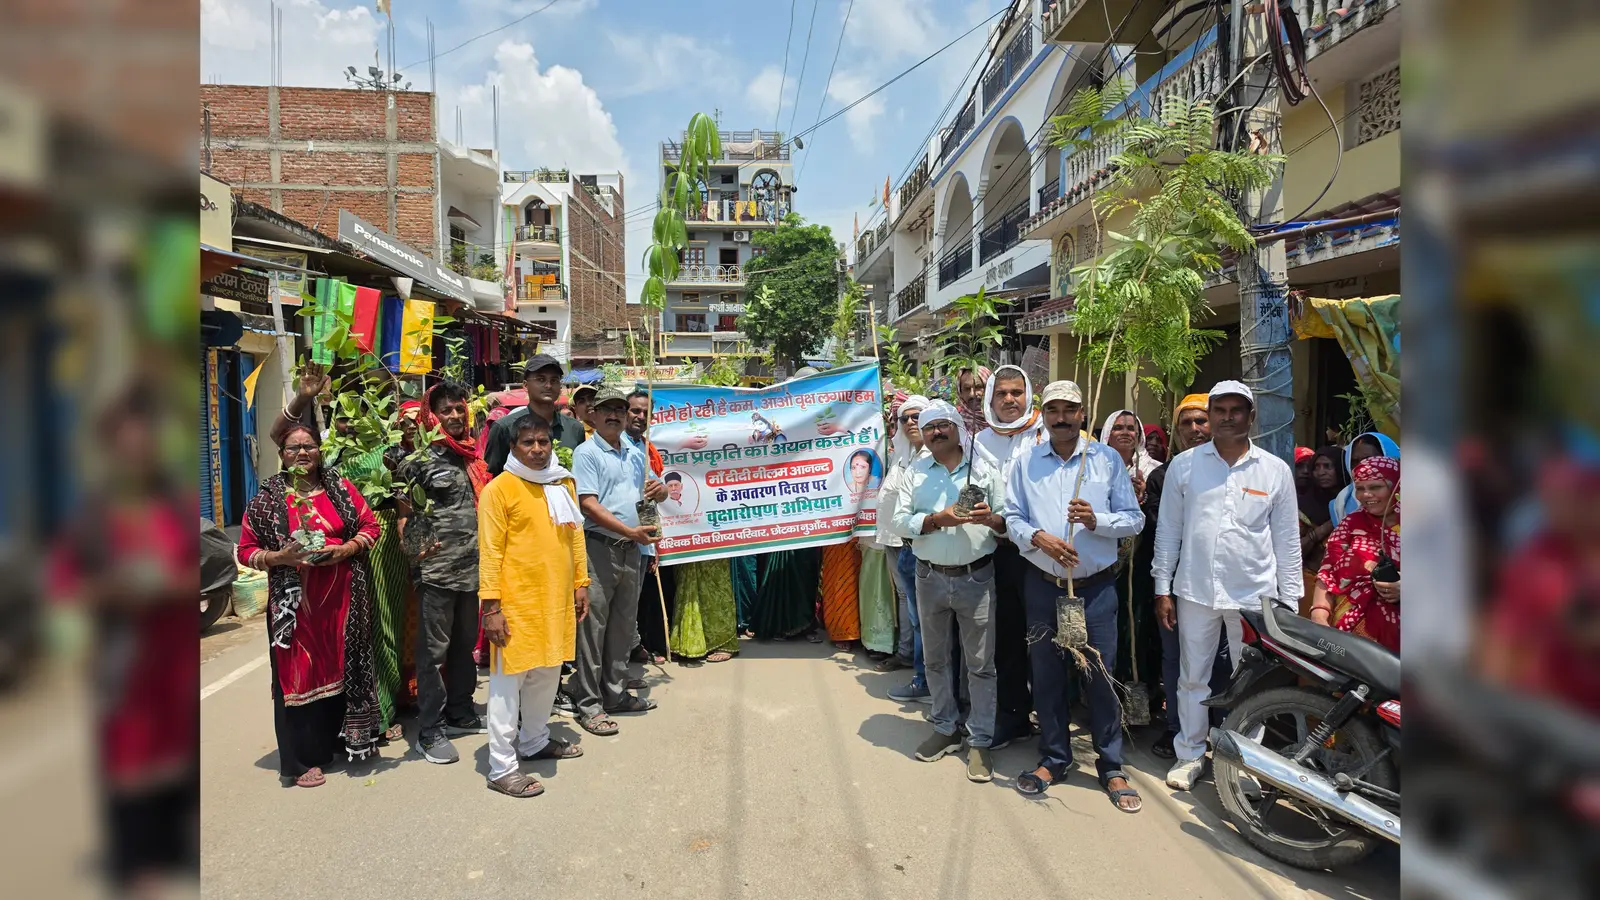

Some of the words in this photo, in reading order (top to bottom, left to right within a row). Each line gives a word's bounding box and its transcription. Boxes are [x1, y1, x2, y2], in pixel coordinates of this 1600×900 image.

[353, 222, 425, 269] Panasonic
[206, 273, 239, 289] त्यम
[678, 402, 692, 422] हो
[694, 398, 716, 418] रही
[717, 398, 727, 416] है
[760, 392, 794, 410] आओ
[795, 393, 816, 410] वृक्ष
[853, 390, 876, 404] हम
[690, 443, 742, 467] प्रकृति
[744, 444, 769, 458] का
[770, 438, 814, 455] अयन
[814, 430, 856, 449] करते
[708, 472, 725, 485] माँ
[725, 469, 752, 483] दीदी
[752, 466, 788, 480] नीलम
[789, 462, 831, 477] आनन्द
[715, 488, 728, 503] के
[730, 484, 777, 502] अवतरण
[778, 480, 811, 496] दिवस
[812, 478, 828, 492] पर
[706, 502, 779, 528] वृक्षारोपण
[780, 494, 844, 517] अभियान
[658, 537, 691, 550] वैश्विक
[692, 534, 711, 546] शिव
[711, 531, 735, 543] शिष्य
[770, 524, 800, 536] छोटका
[1317, 638, 1346, 657] LIVA
